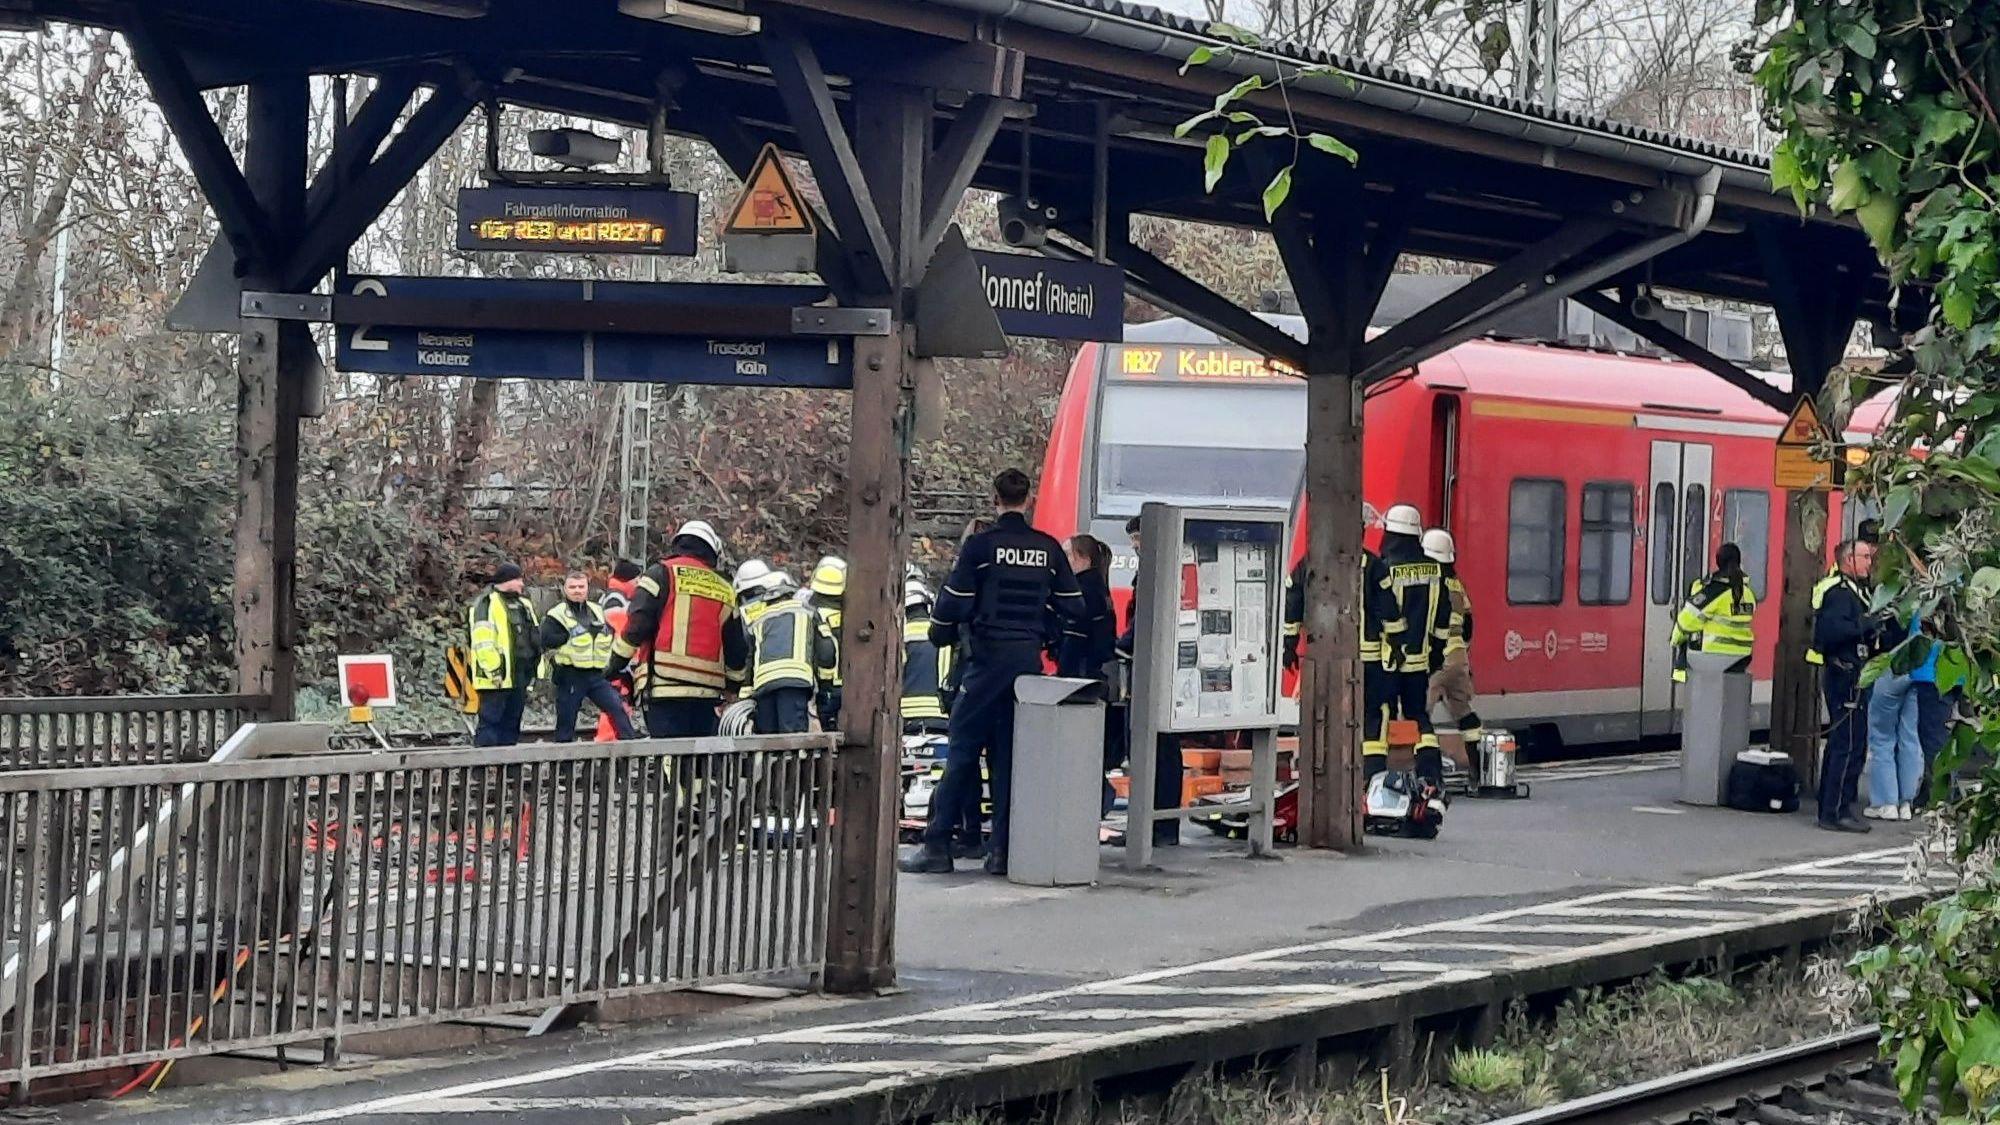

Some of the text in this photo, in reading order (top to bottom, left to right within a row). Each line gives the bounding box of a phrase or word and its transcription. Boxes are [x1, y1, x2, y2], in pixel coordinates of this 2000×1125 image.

[505, 201, 628, 219] Fahrgastinformation
[981, 265, 1093, 319] onnef (Rhein)
[351, 279, 389, 350] 2
[418, 351, 470, 367] Koblenz
[736, 359, 768, 377] Köln
[1123, 350, 1162, 375] RB27
[1178, 350, 1270, 377] Koblenz
[1713, 488, 1722, 521] 2
[996, 547, 1048, 567] POLIZEI
